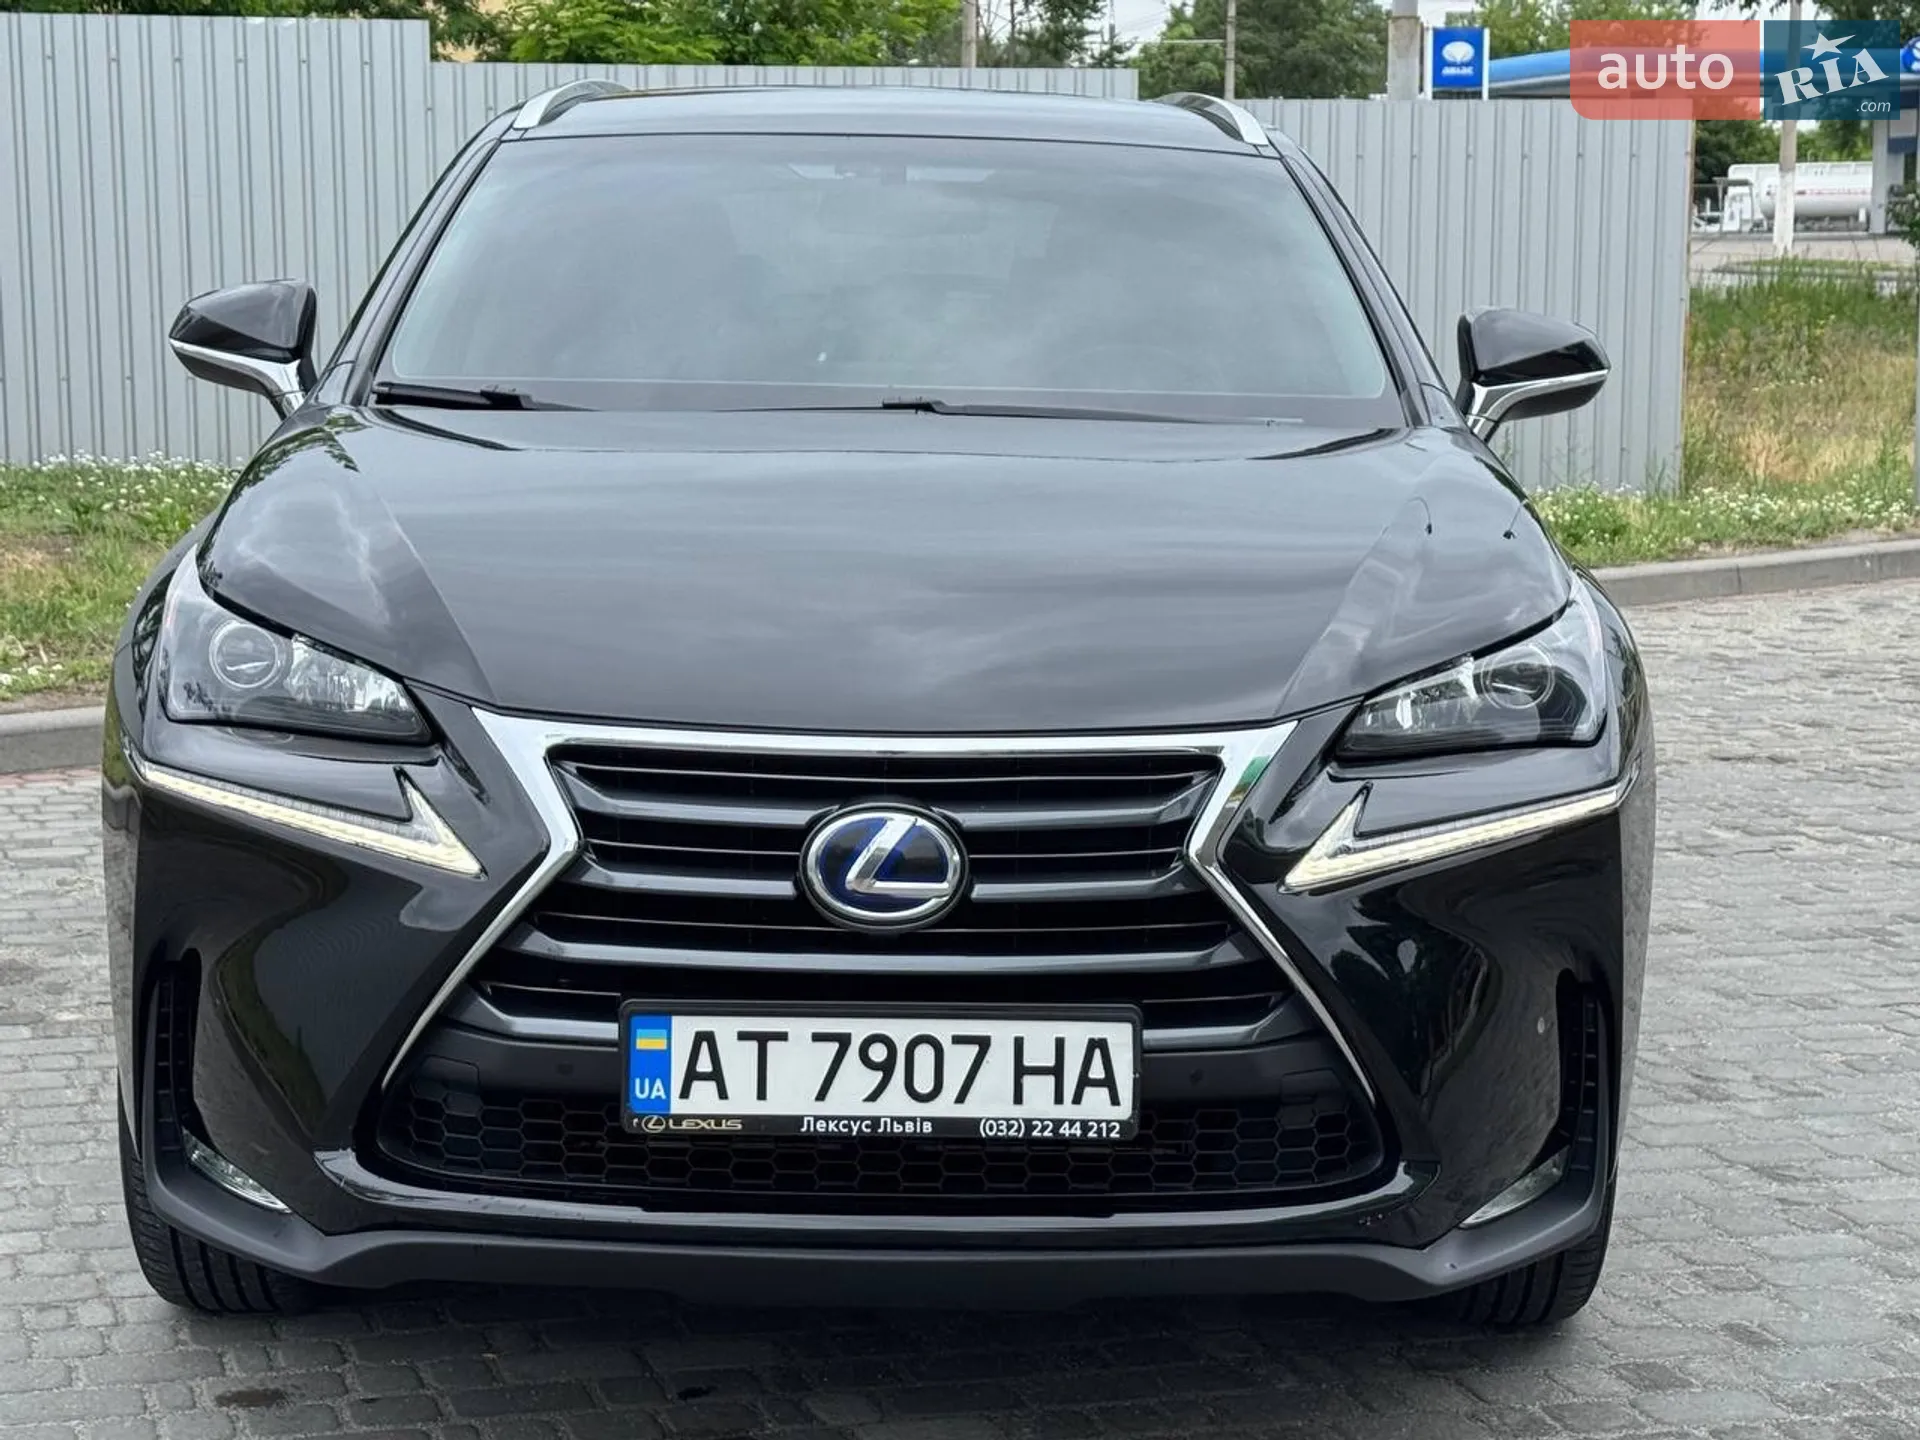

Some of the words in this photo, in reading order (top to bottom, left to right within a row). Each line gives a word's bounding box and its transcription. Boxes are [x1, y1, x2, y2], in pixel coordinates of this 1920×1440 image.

[679, 1030, 789, 1100] AT
[811, 1032, 992, 1103] 7907
[1012, 1036, 1122, 1107] HA
[635, 1079, 667, 1099] UA
[668, 1119, 743, 1131] LEXUS
[800, 1116, 872, 1135] Лексус
[877, 1117, 933, 1134] Львів
[979, 1118, 1026, 1138] (032)
[1031, 1120, 1053, 1137] 22
[1059, 1121, 1082, 1138] 44
[1087, 1121, 1121, 1138] 212
